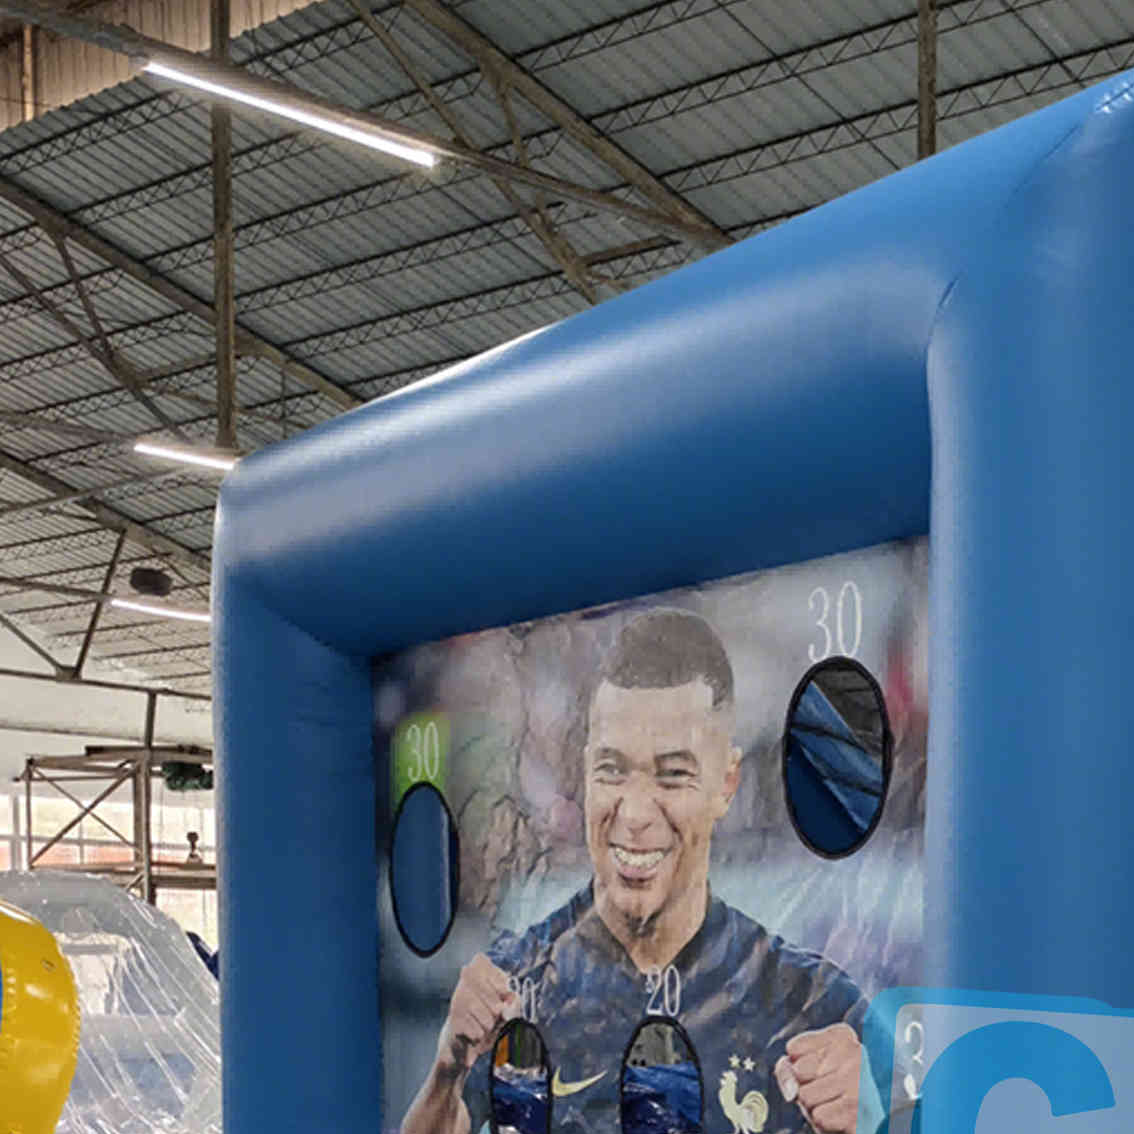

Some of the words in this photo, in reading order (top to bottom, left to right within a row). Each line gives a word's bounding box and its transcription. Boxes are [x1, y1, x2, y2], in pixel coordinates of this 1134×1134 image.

[807, 581, 862, 662] 30
[407, 721, 440, 782] 30
[646, 964, 681, 1016] 20
